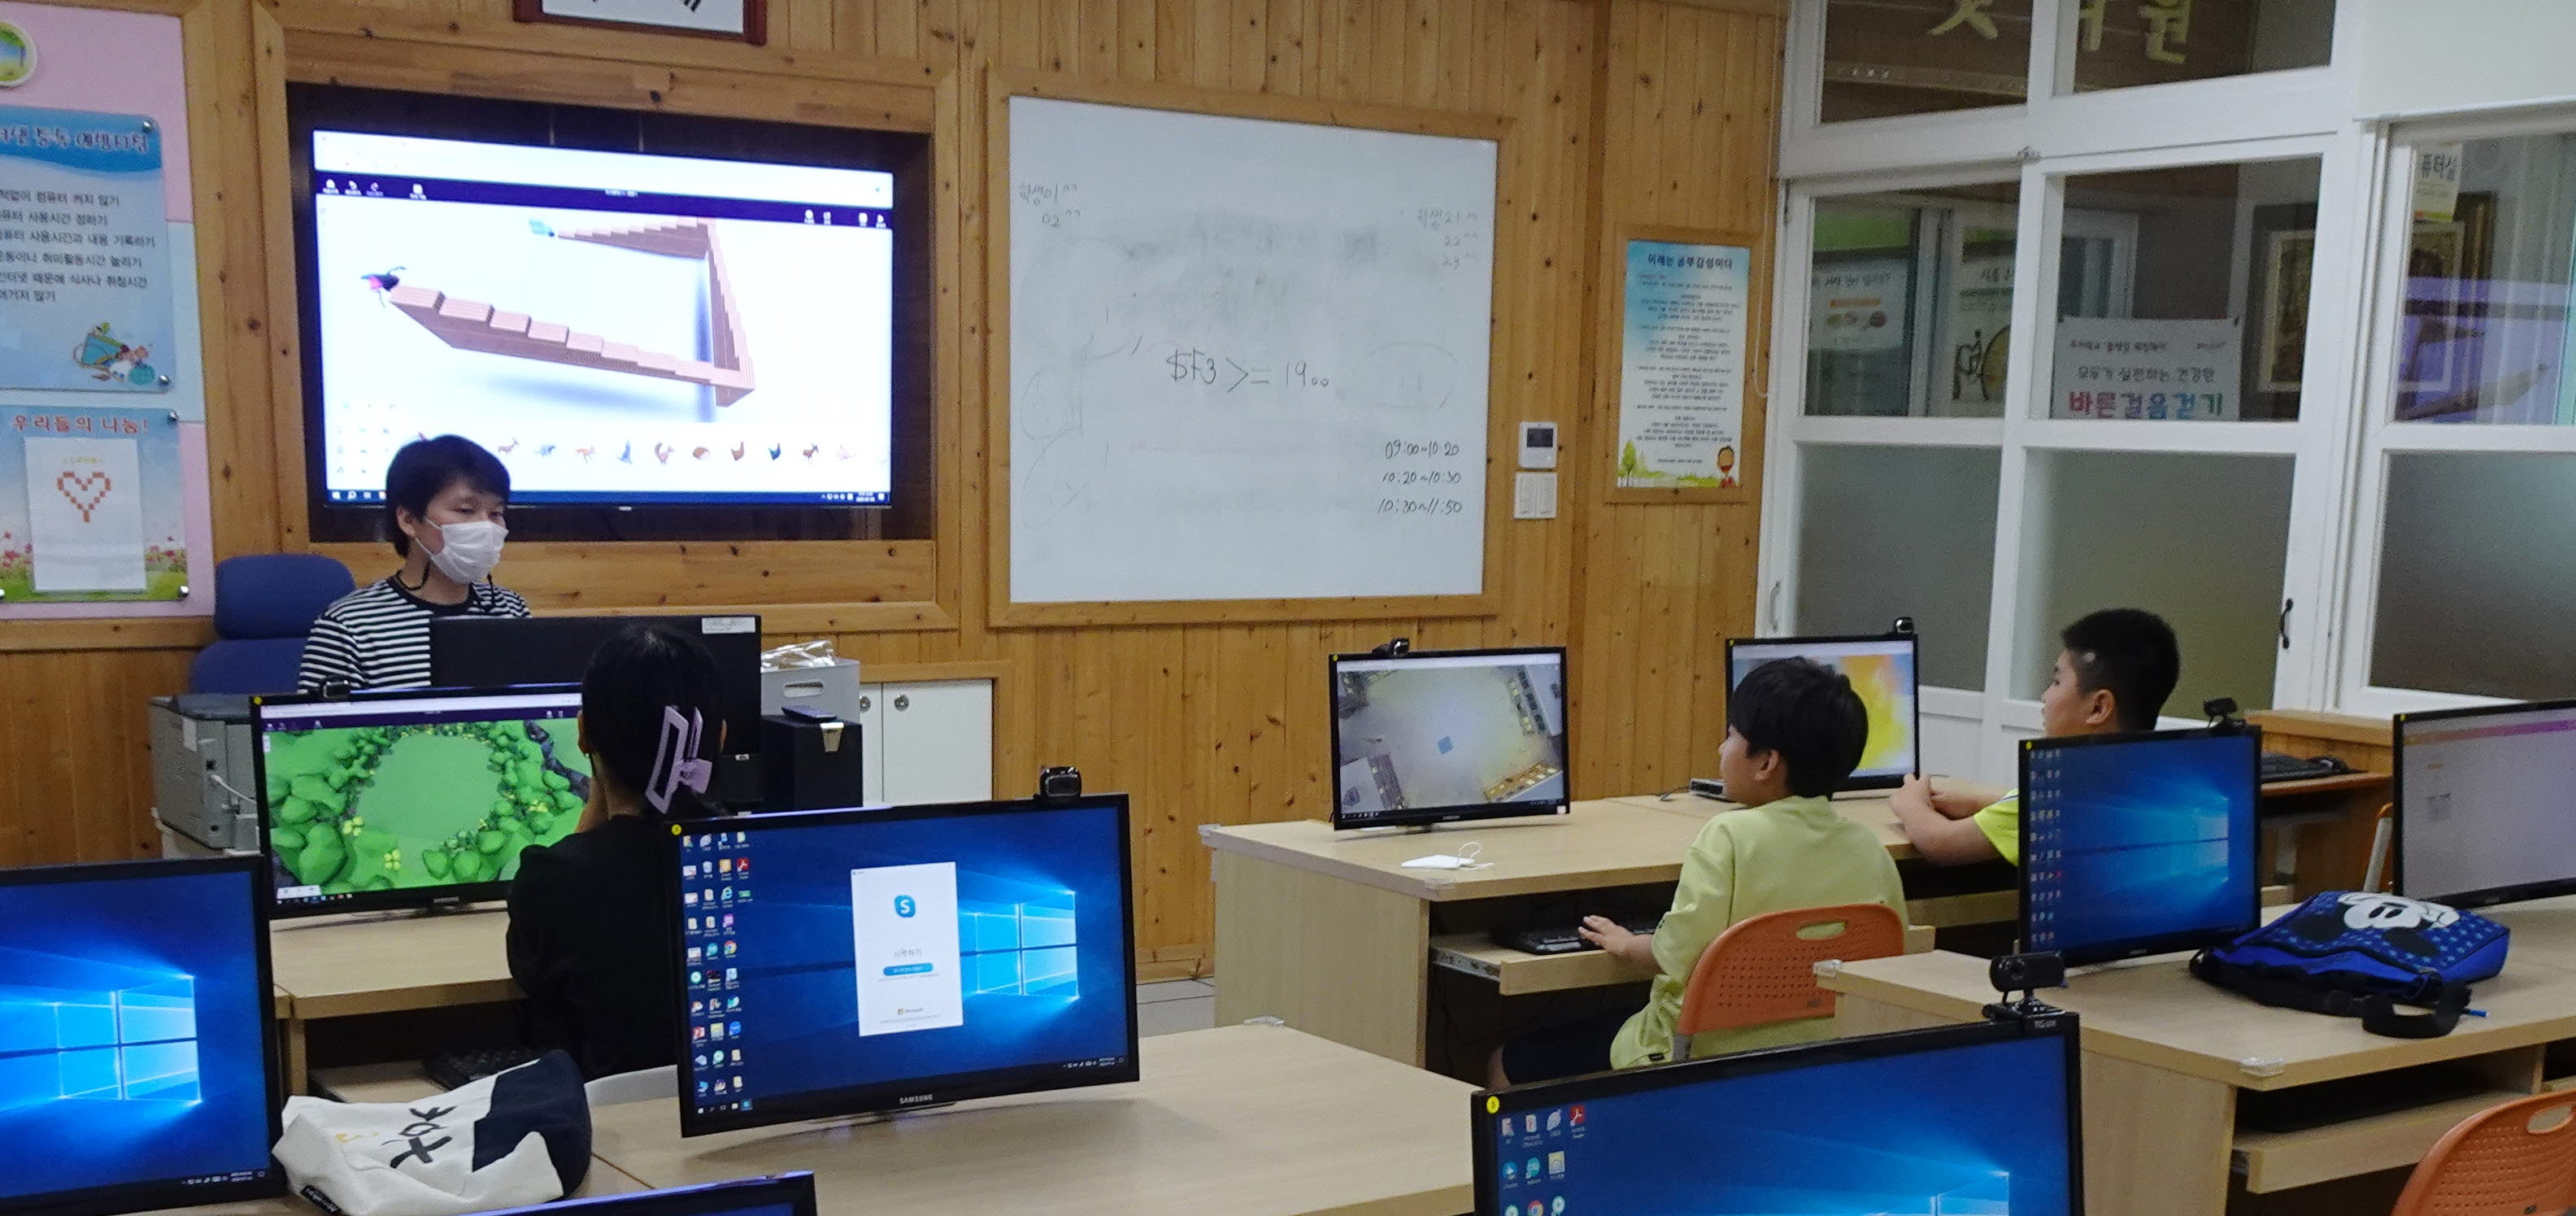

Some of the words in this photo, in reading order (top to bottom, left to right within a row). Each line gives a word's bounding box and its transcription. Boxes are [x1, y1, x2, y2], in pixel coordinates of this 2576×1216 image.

[37, 190, 67, 204] 컴퓨터
[28, 211, 71, 225] 사용시간
[75, 212, 107, 226] 정하기
[0, 229, 25, 242] 퓨터
[29, 230, 82, 245] 사용시간과
[88, 232, 108, 246] 내용
[42, 252, 106, 267] 취미활동시간
[110, 254, 142, 268] 늘리기
[107, 274, 147, 289] 취침시간
[13, 414, 91, 433] 우리들의
[102, 415, 148, 434] 나눔!
[899, 1094, 933, 1105] SAMSUNG
